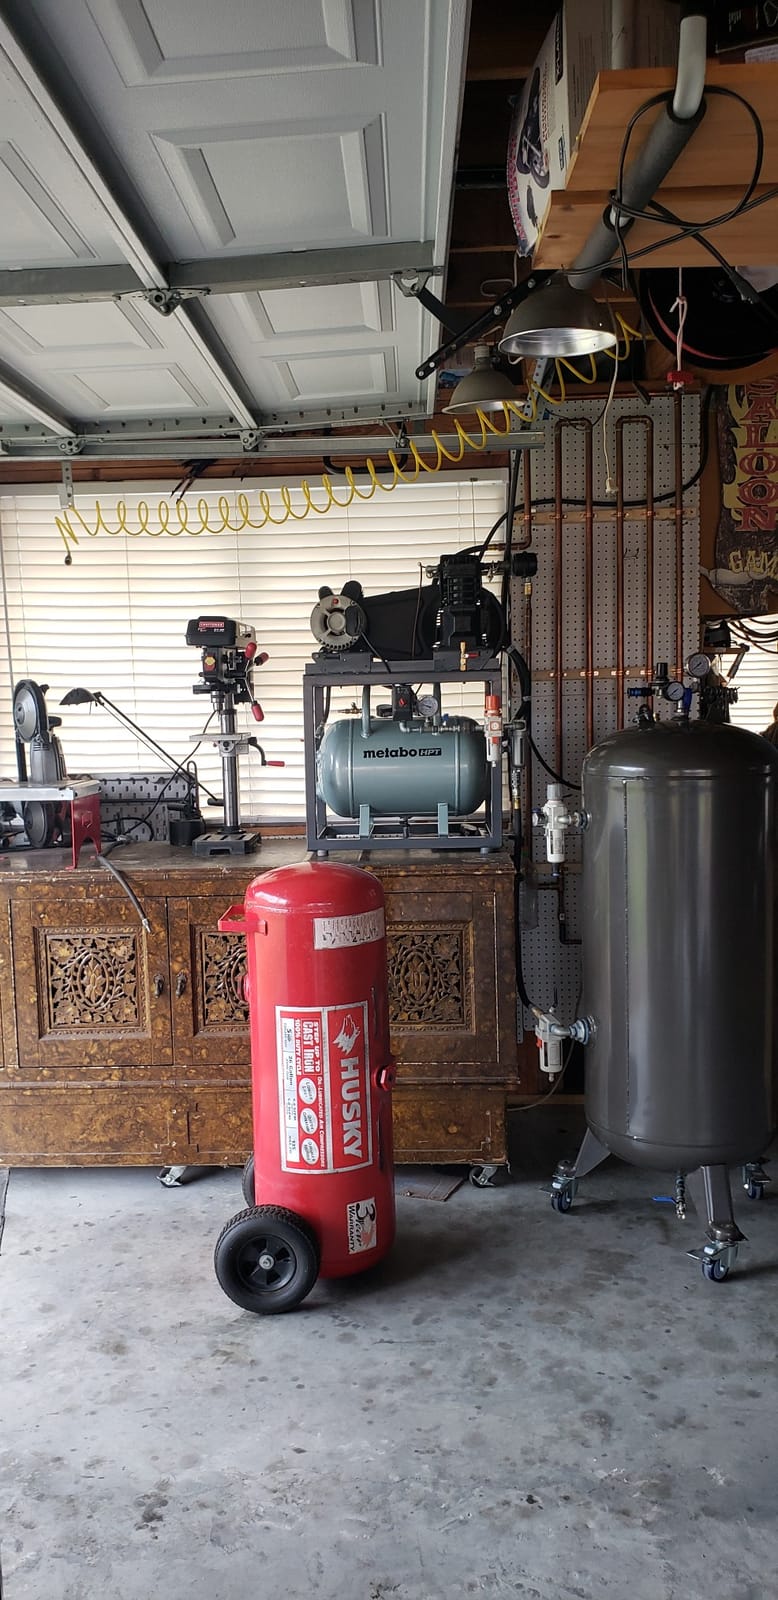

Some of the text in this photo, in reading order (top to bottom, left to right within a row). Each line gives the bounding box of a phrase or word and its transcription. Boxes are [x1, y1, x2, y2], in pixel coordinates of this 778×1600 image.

[363, 746, 441, 758] metabo HPT
[302, 1021, 315, 1072] CAST IRON
[314, 1046, 320, 1057] UP
[315, 1059, 321, 1072] TO
[341, 1057, 363, 1158] HUSKY
[356, 1203, 376, 1222] 3
[348, 1205, 356, 1252] WARRANTY
